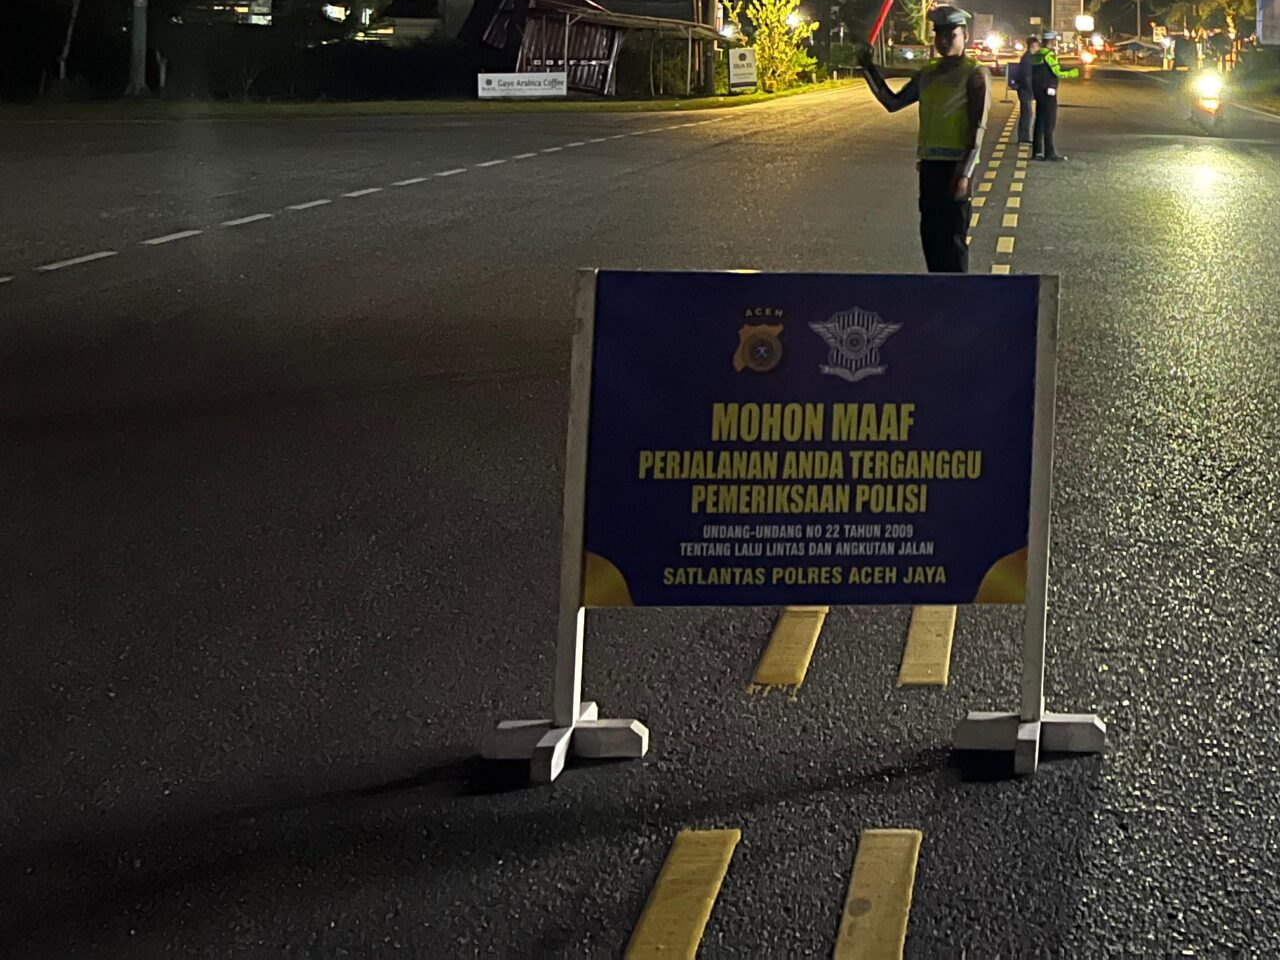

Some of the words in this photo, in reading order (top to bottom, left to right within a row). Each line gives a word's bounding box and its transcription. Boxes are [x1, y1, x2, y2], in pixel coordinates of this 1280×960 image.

[497, 79, 515, 87] Gayo
[516, 79, 542, 87] Arabica
[543, 78, 564, 88] Coffee
[745, 307, 784, 318] ACEH
[711, 403, 824, 441] MOHON
[831, 403, 916, 441] MAAF
[639, 450, 778, 480] PERJALANAN
[782, 450, 845, 480] ANDA
[849, 450, 983, 480] TERGANGGU
[691, 485, 850, 514] PEMERIKSAAN
[855, 484, 928, 513] POLISI
[703, 525, 802, 539] UNDANG-UNDANG
[805, 525, 822, 538] NO
[825, 524, 841, 538] 22
[843, 524, 881, 538] TAHUN
[885, 524, 914, 538] 2009
[680, 542, 731, 557] TENTANG
[734, 542, 763, 557] LALU
[766, 542, 806, 557] LINTAS
[808, 542, 832, 556] DAN
[835, 542, 896, 556] ANGKUTAN
[898, 541, 934, 556] JALAN
[663, 567, 766, 585] SATLANTAS
[772, 567, 843, 585] POLRES
[848, 567, 897, 584] ACEH
[903, 566, 947, 584] JAYA
